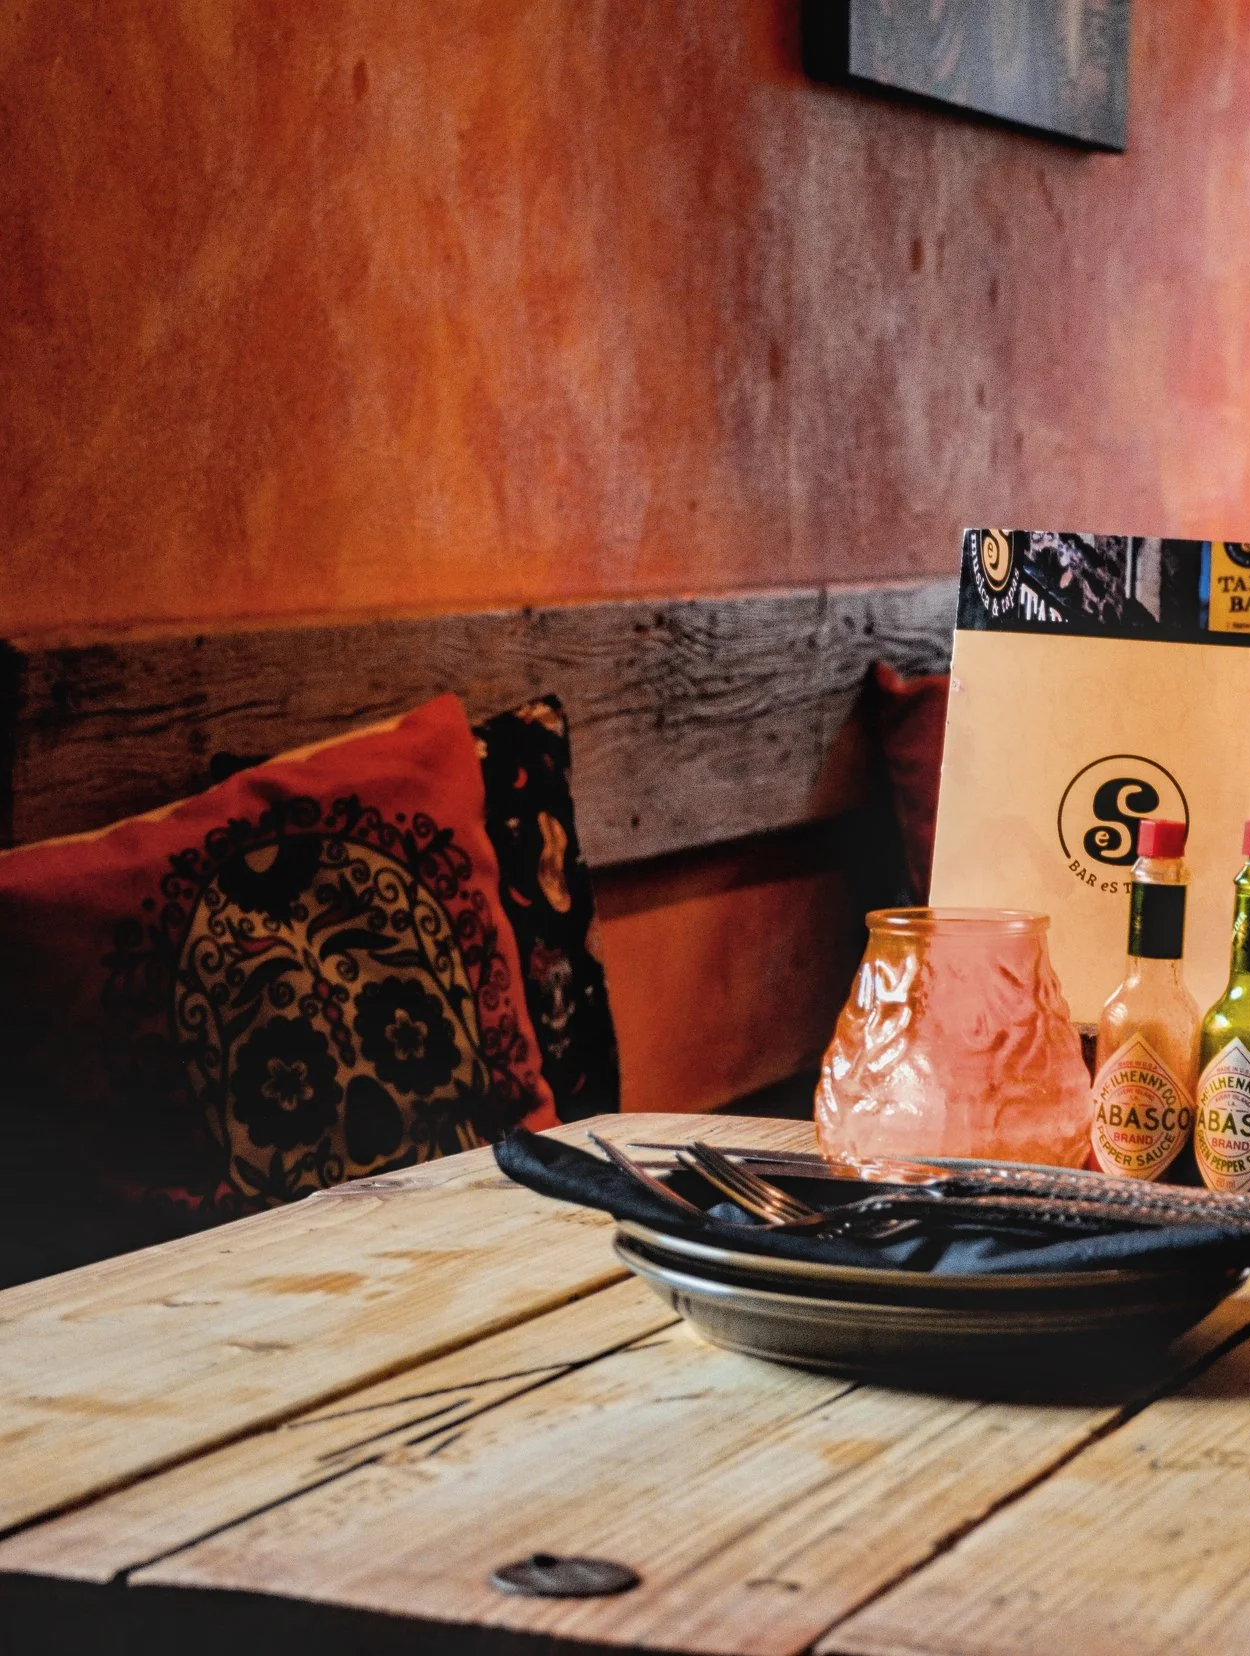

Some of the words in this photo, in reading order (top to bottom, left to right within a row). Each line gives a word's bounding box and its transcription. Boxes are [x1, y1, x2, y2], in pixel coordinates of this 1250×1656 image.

[1068, 860, 1096, 888] BAR
[1096, 1102, 1190, 1131] ABASCO
[1097, 1124, 1132, 1166] PEPPER
[1136, 1131, 1175, 1166] SAUCE
[1113, 1132, 1153, 1145] BRAND
[1211, 1137, 1250, 1151] BRAND
[1210, 1154, 1246, 1173] PEPPER
